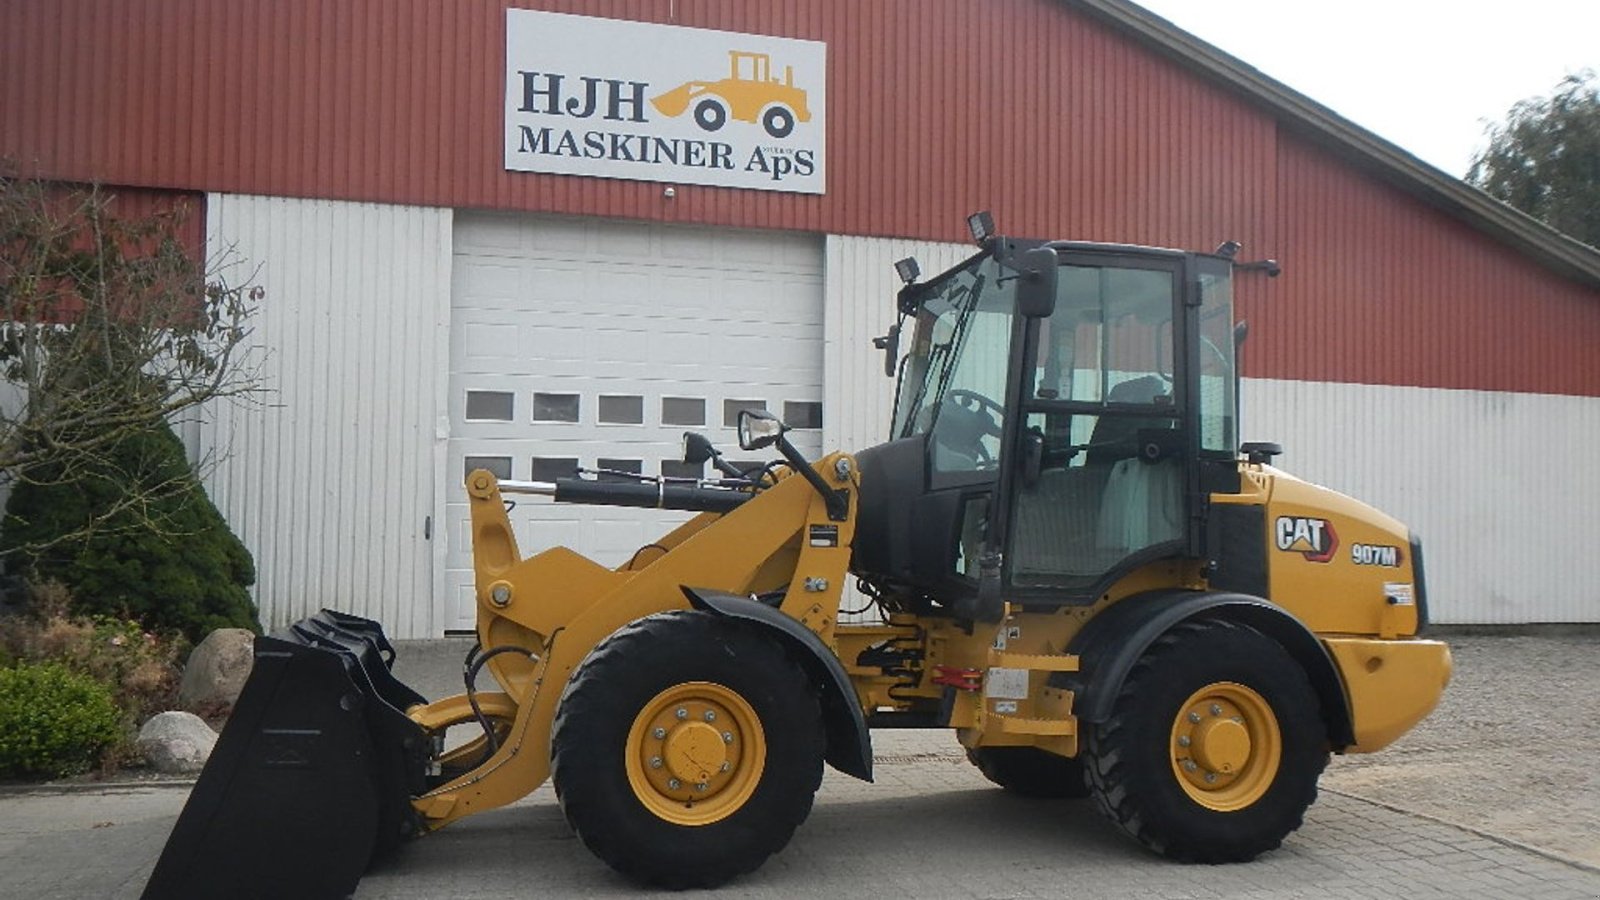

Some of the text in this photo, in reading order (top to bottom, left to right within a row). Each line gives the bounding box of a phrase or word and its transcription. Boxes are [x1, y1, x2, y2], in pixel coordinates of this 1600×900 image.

[517, 71, 649, 123] HJH
[517, 125, 815, 181] MASKINER ApS
[1276, 516, 1324, 551] CAT
[1352, 544, 1396, 566] 907M
